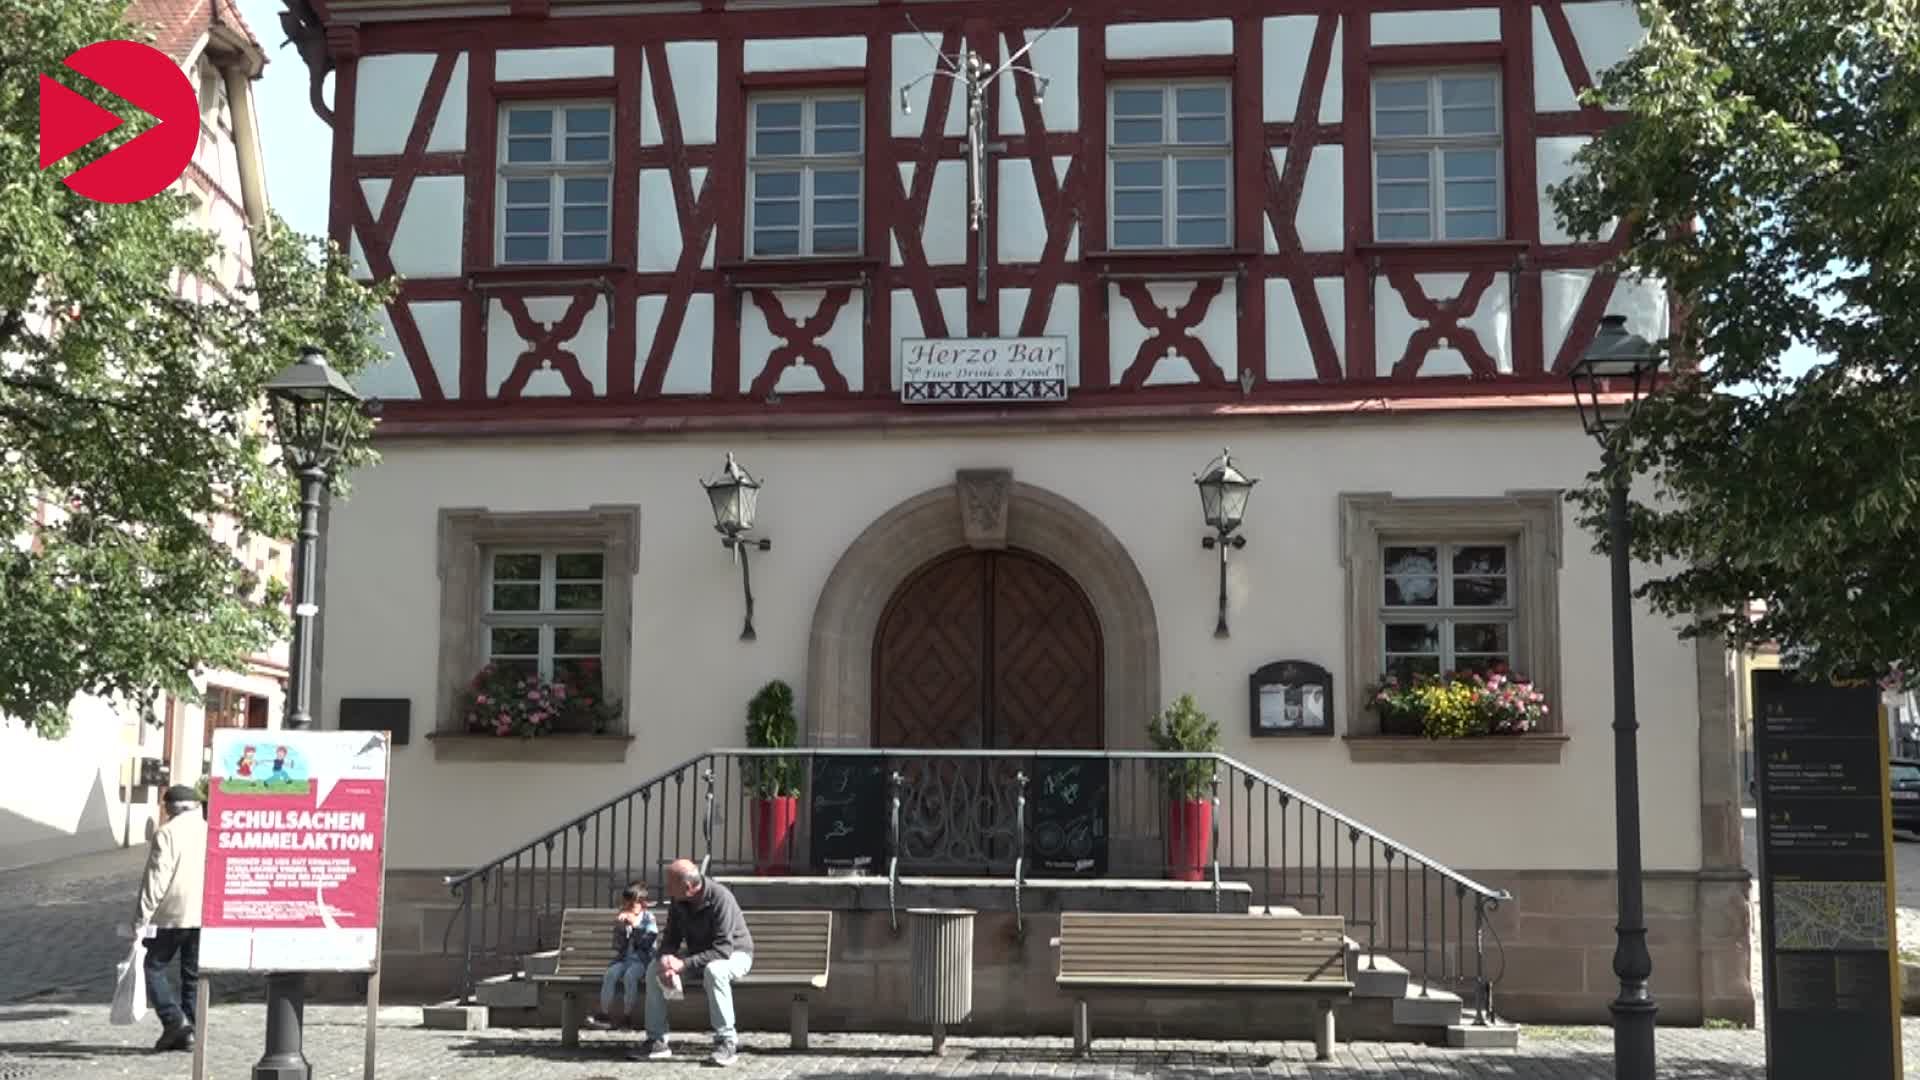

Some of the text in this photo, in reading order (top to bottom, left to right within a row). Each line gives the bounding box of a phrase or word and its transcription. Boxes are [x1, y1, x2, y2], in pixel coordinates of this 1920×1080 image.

[908, 342, 1062, 365] Herzo Bar
[925, 366, 1051, 379] Fine Drinks & Food
[220, 810, 365, 830] SCHULSACHEN
[218, 832, 374, 850] SAMMELAKTION
